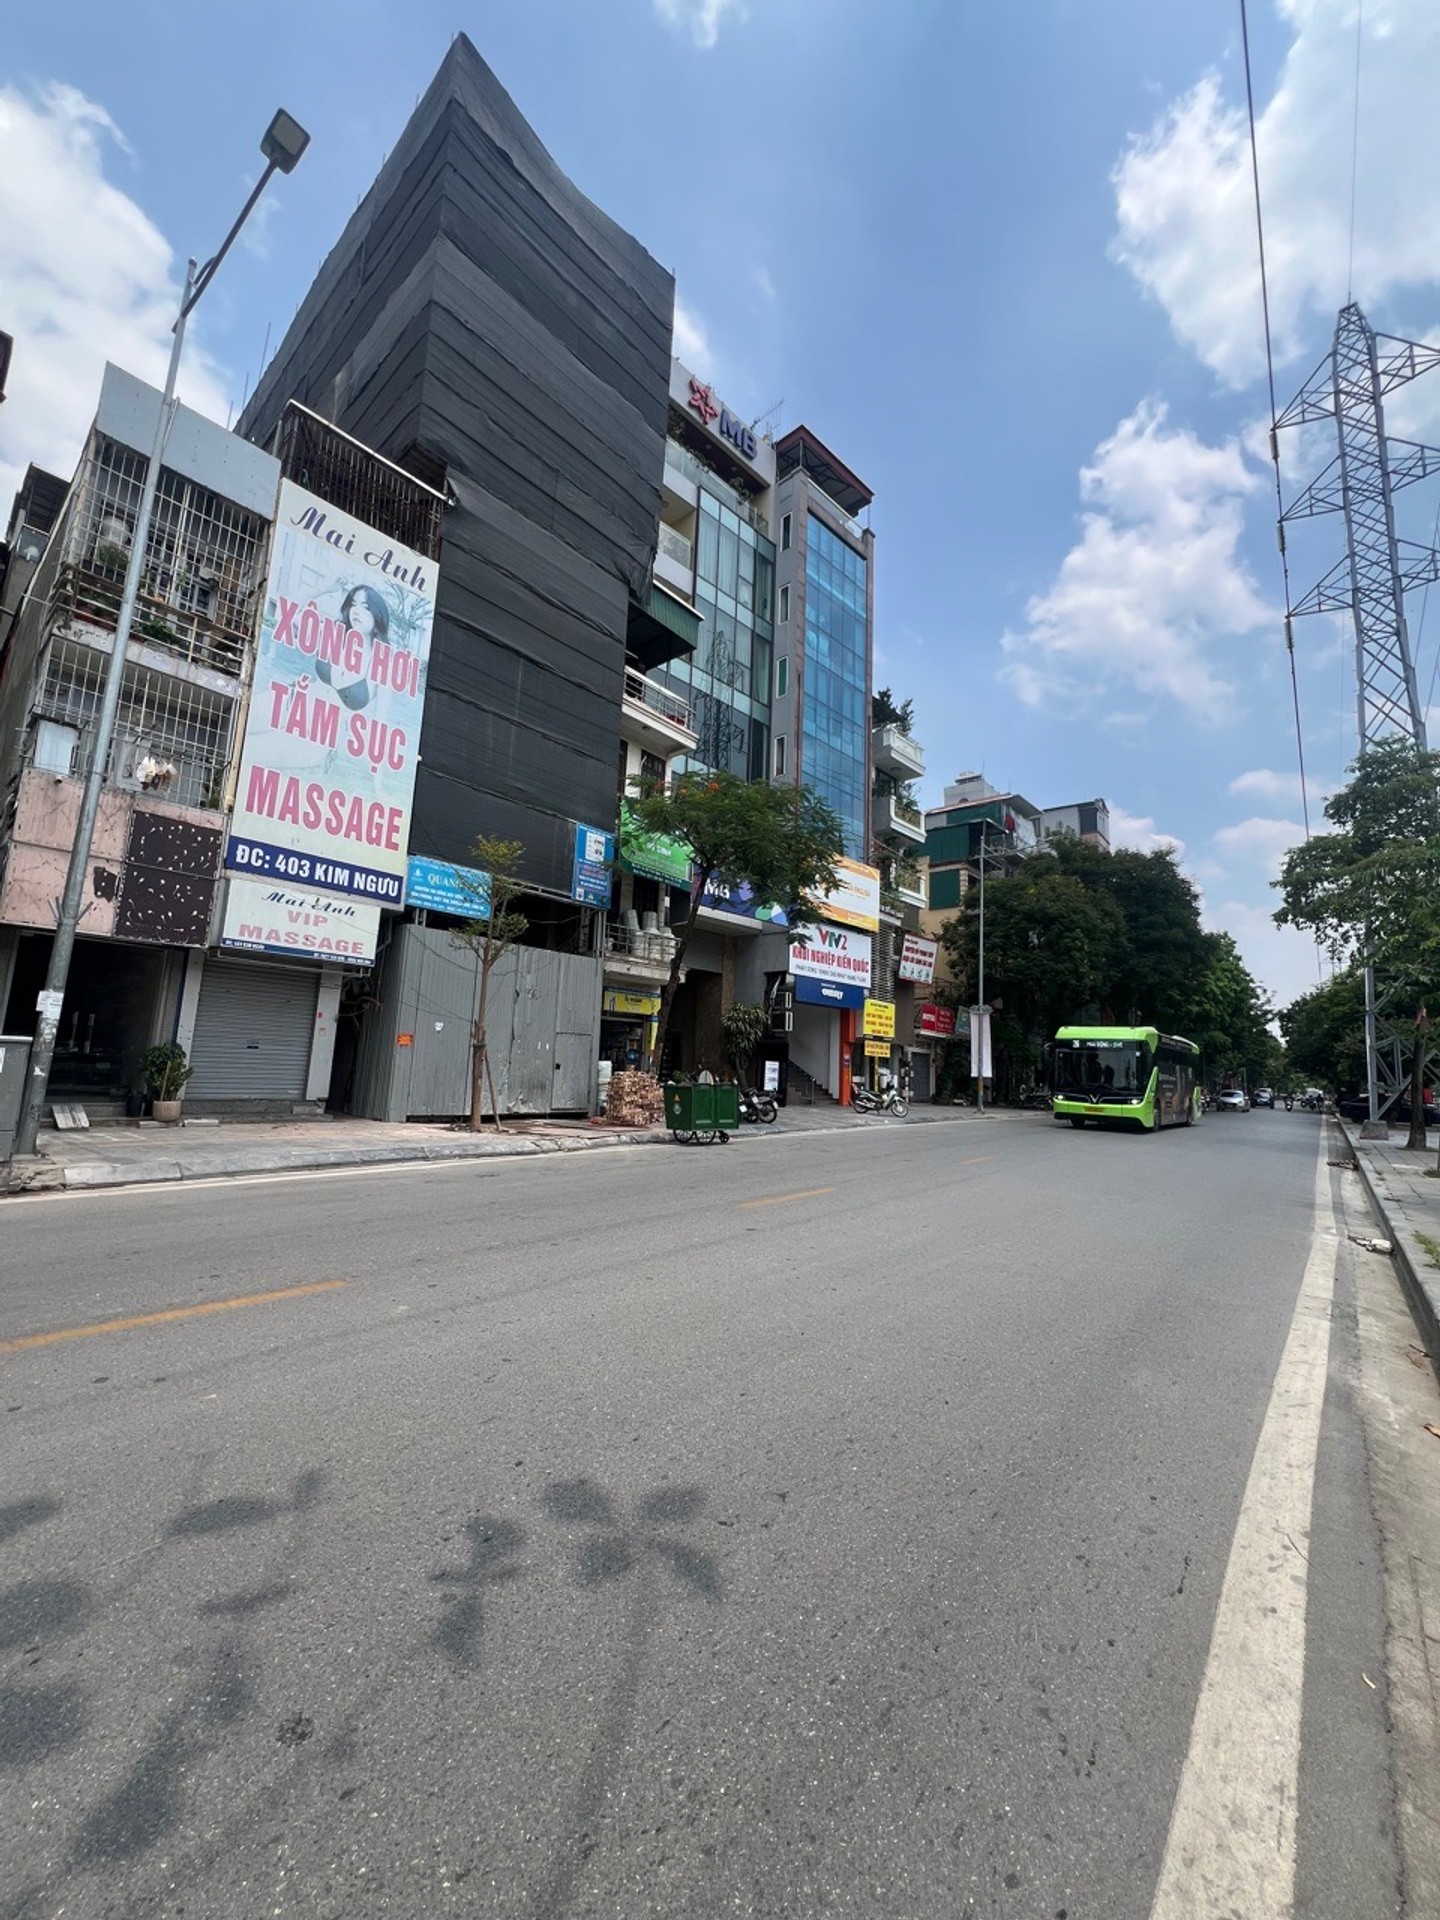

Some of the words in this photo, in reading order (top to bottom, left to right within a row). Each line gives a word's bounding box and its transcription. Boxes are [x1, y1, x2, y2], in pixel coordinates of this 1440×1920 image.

[720, 409, 758, 460] MB
[290, 506, 356, 555] Mai
[363, 549, 427, 592] Anh
[272, 596, 365, 675] XÔNG
[370, 640, 420, 698] HƠI
[270, 675, 341, 749] TẮM
[346, 713, 407, 774] SỤC
[245, 764, 403, 851] MASSAGE
[235, 844, 270, 869] ĐC:
[274, 854, 311, 878] 403
[314, 863, 351, 887] KIM
[353, 872, 399, 898] NGƯU
[262, 892, 306, 906] Mai
[311, 897, 356, 917] Anh
[288, 910, 329, 928] VIP
[238, 924, 364, 955] MASSAGE
[818, 928, 848, 950] VTV2
